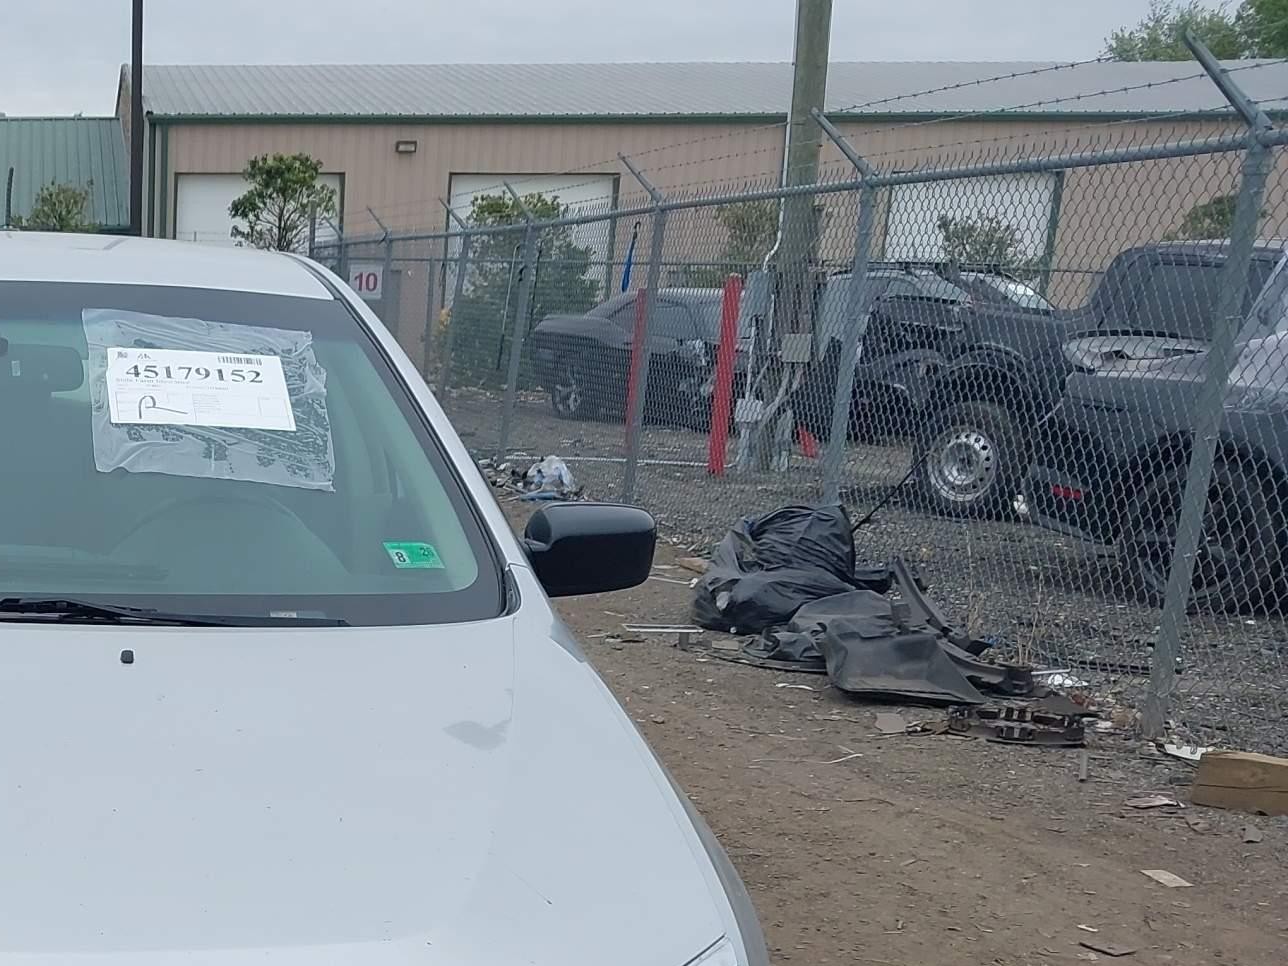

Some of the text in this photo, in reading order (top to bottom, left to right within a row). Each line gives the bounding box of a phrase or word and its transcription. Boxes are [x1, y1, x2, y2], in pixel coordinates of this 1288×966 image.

[354, 271, 378, 292] 10
[126, 364, 263, 383] 45179152
[395, 551, 407, 563] 8
